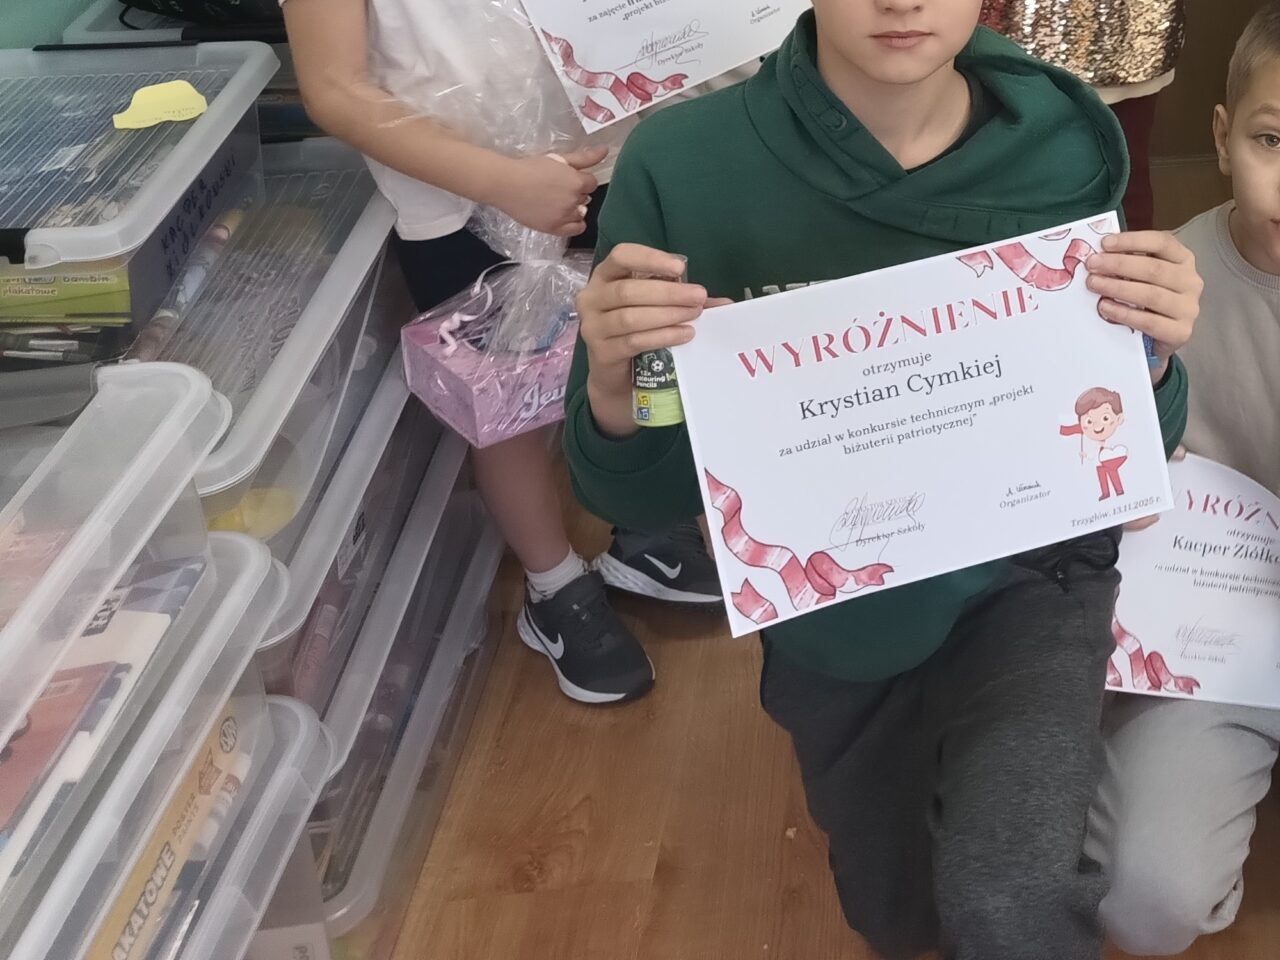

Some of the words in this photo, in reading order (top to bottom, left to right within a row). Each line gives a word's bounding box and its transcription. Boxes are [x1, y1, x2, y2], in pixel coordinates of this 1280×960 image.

[587, 15, 597, 23] za
[598, 3, 627, 19] zajęcie
[737, 285, 1040, 379] WYRÓŻNIENIE
[862, 352, 932, 378] otrzymuje
[800, 383, 901, 420] Krystian
[907, 354, 1003, 396] Cymkiej
[779, 447, 794, 458] za
[795, 434, 831, 453] udział
[834, 435, 844, 444] w
[847, 418, 908, 442] konkursie
[910, 399, 985, 426] technicznym
[843, 433, 895, 456] biżuterii
[999, 489, 1051, 510] Organizator
[1111, 500, 1153, 518] 13.11.2025
[1173, 534, 1230, 558] Kacper
